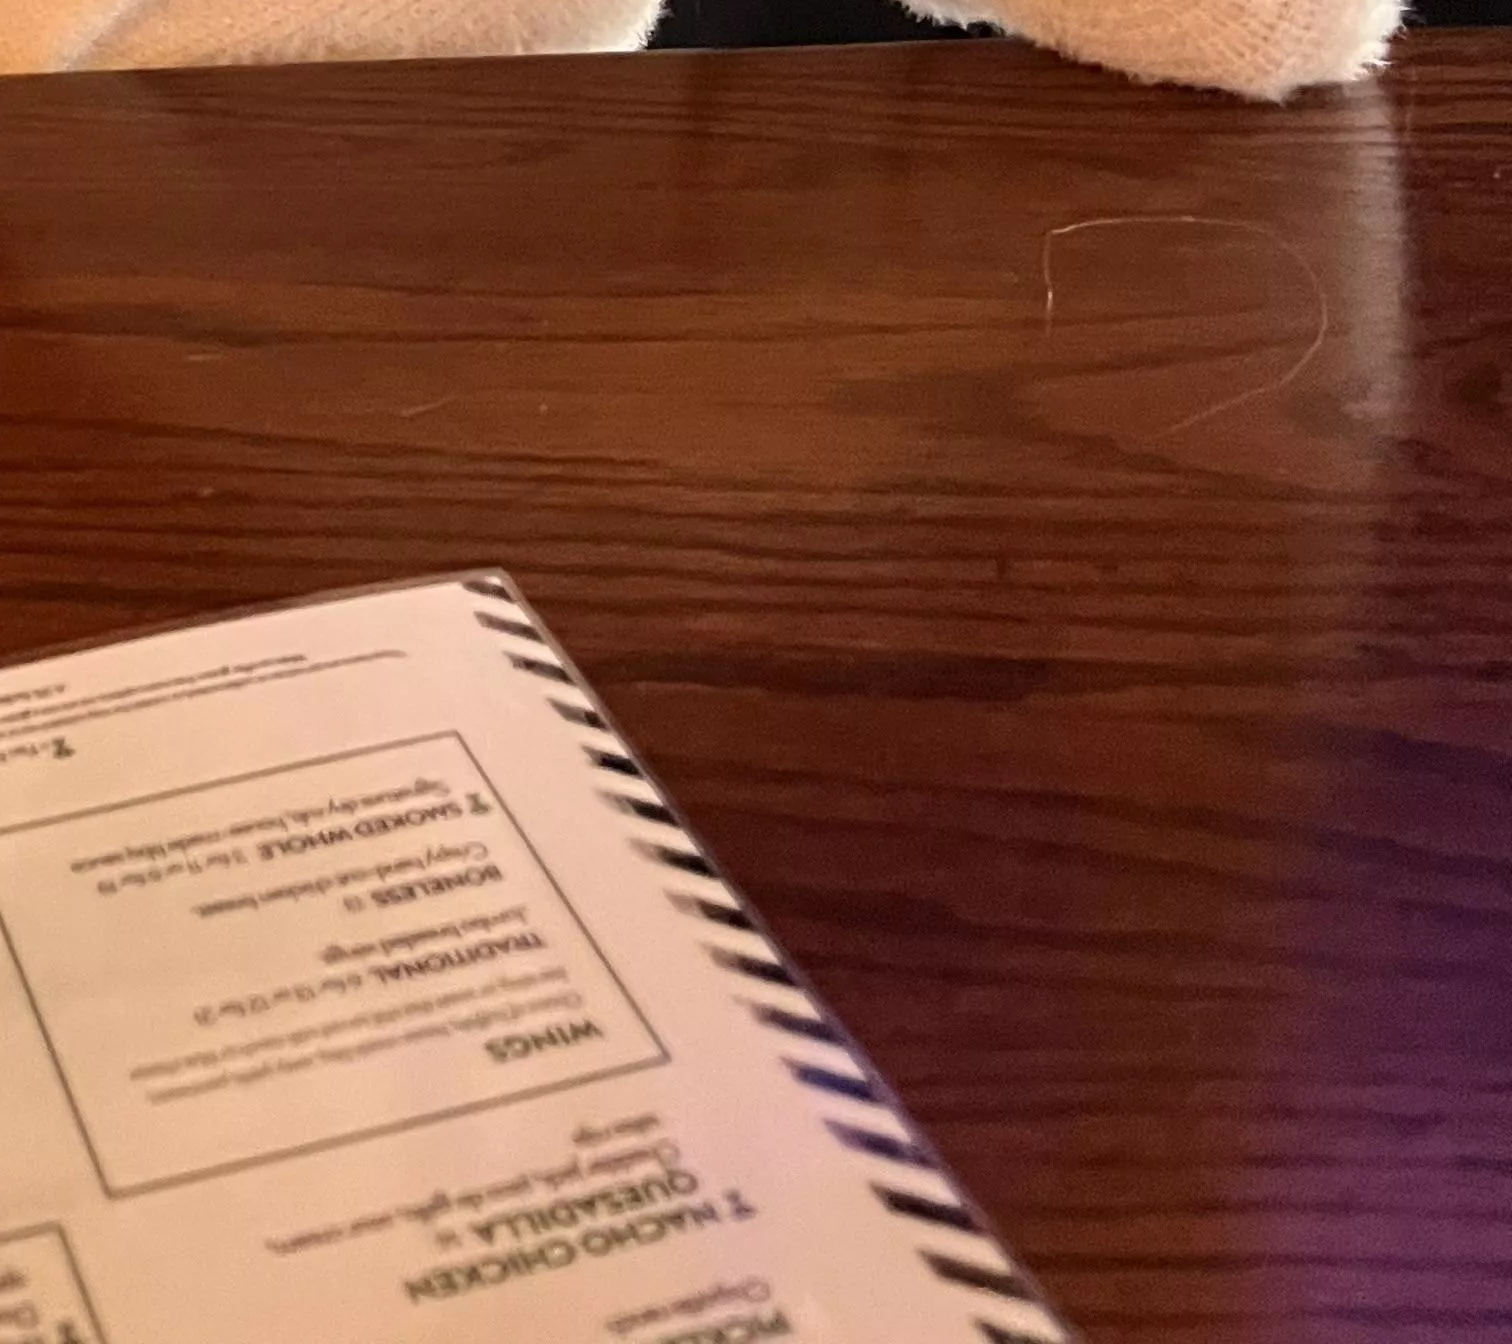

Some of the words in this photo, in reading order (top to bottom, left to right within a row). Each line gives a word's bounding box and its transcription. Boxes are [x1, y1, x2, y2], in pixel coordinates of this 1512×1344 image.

[353, 800, 463, 838] SMOKED
[256, 826, 354, 861] WHOLE
[369, 863, 503, 908] BONELESS
[367, 932, 546, 984] TRADITIONAL
[483, 1019, 604, 1063] WINGS
[469, 1170, 704, 1244] QUESADILLA
[577, 1201, 721, 1257] NACHO
[403, 1239, 577, 1303] CHICKEN
